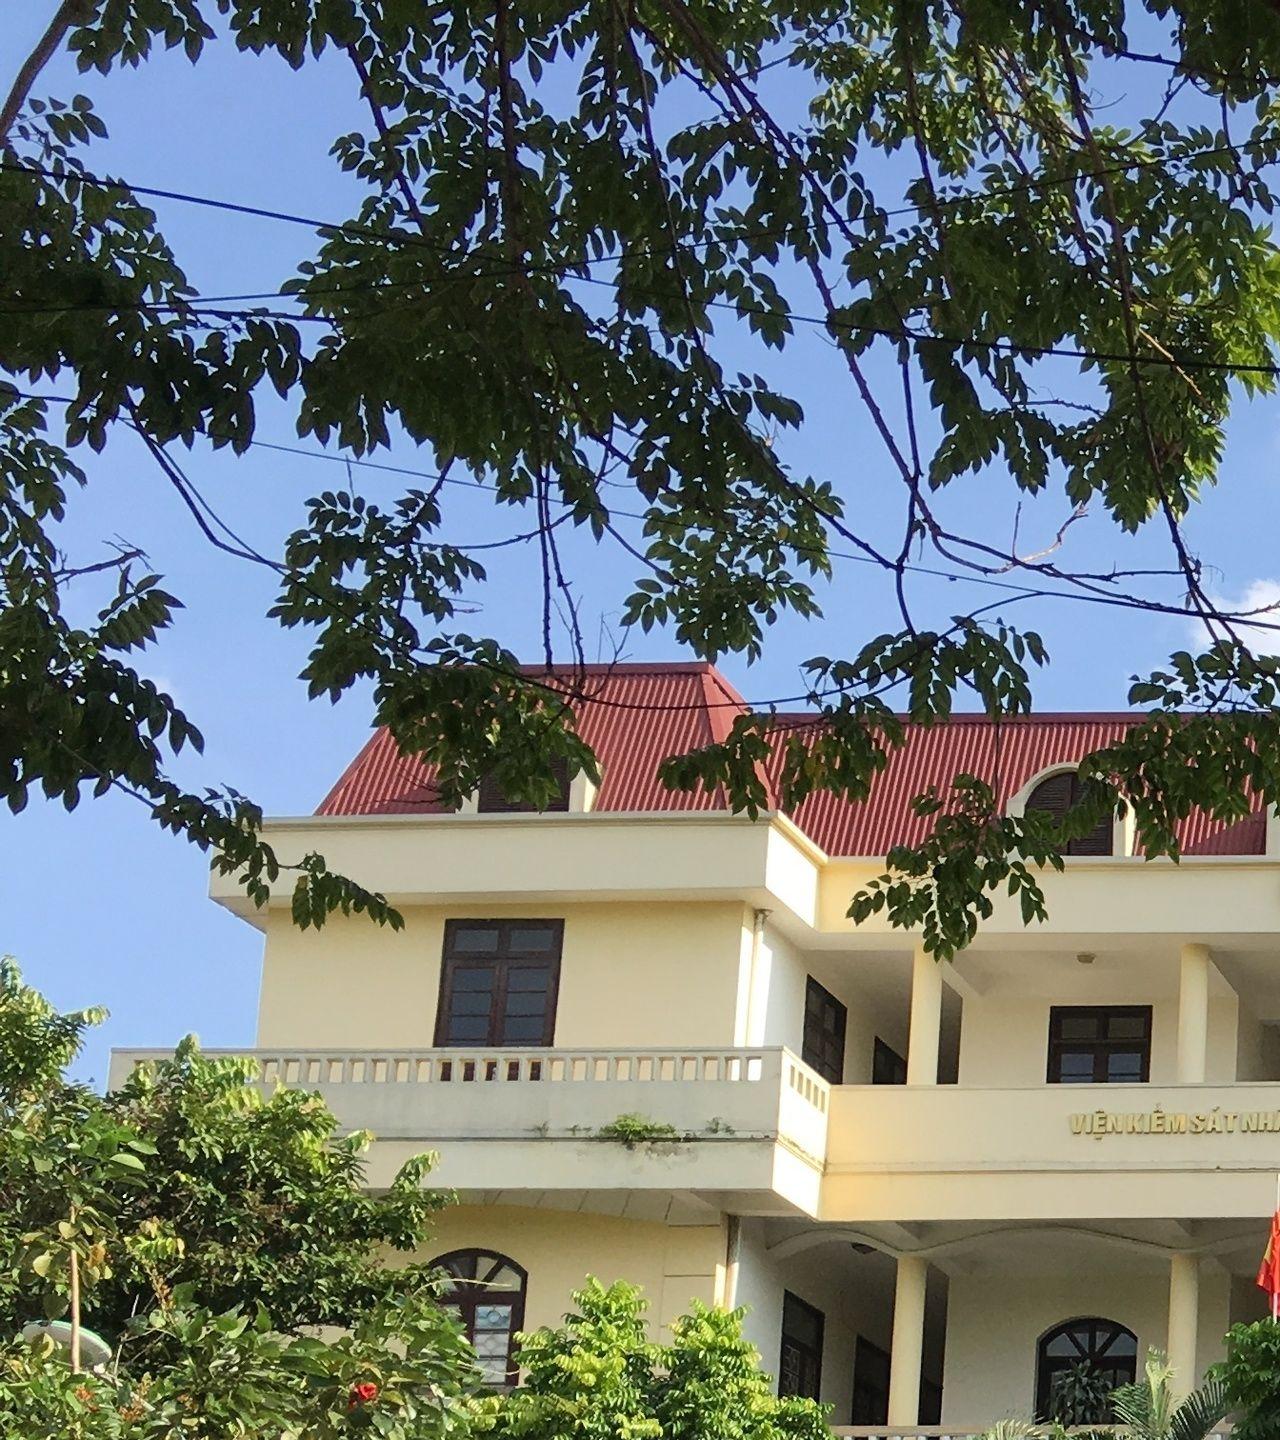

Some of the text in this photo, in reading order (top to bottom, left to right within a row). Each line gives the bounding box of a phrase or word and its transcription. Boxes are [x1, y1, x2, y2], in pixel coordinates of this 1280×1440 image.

[1071, 1109, 1123, 1140] VIỆN
[1126, 1103, 1186, 1135] KIỂM
[1190, 1106, 1237, 1134] SÁT
